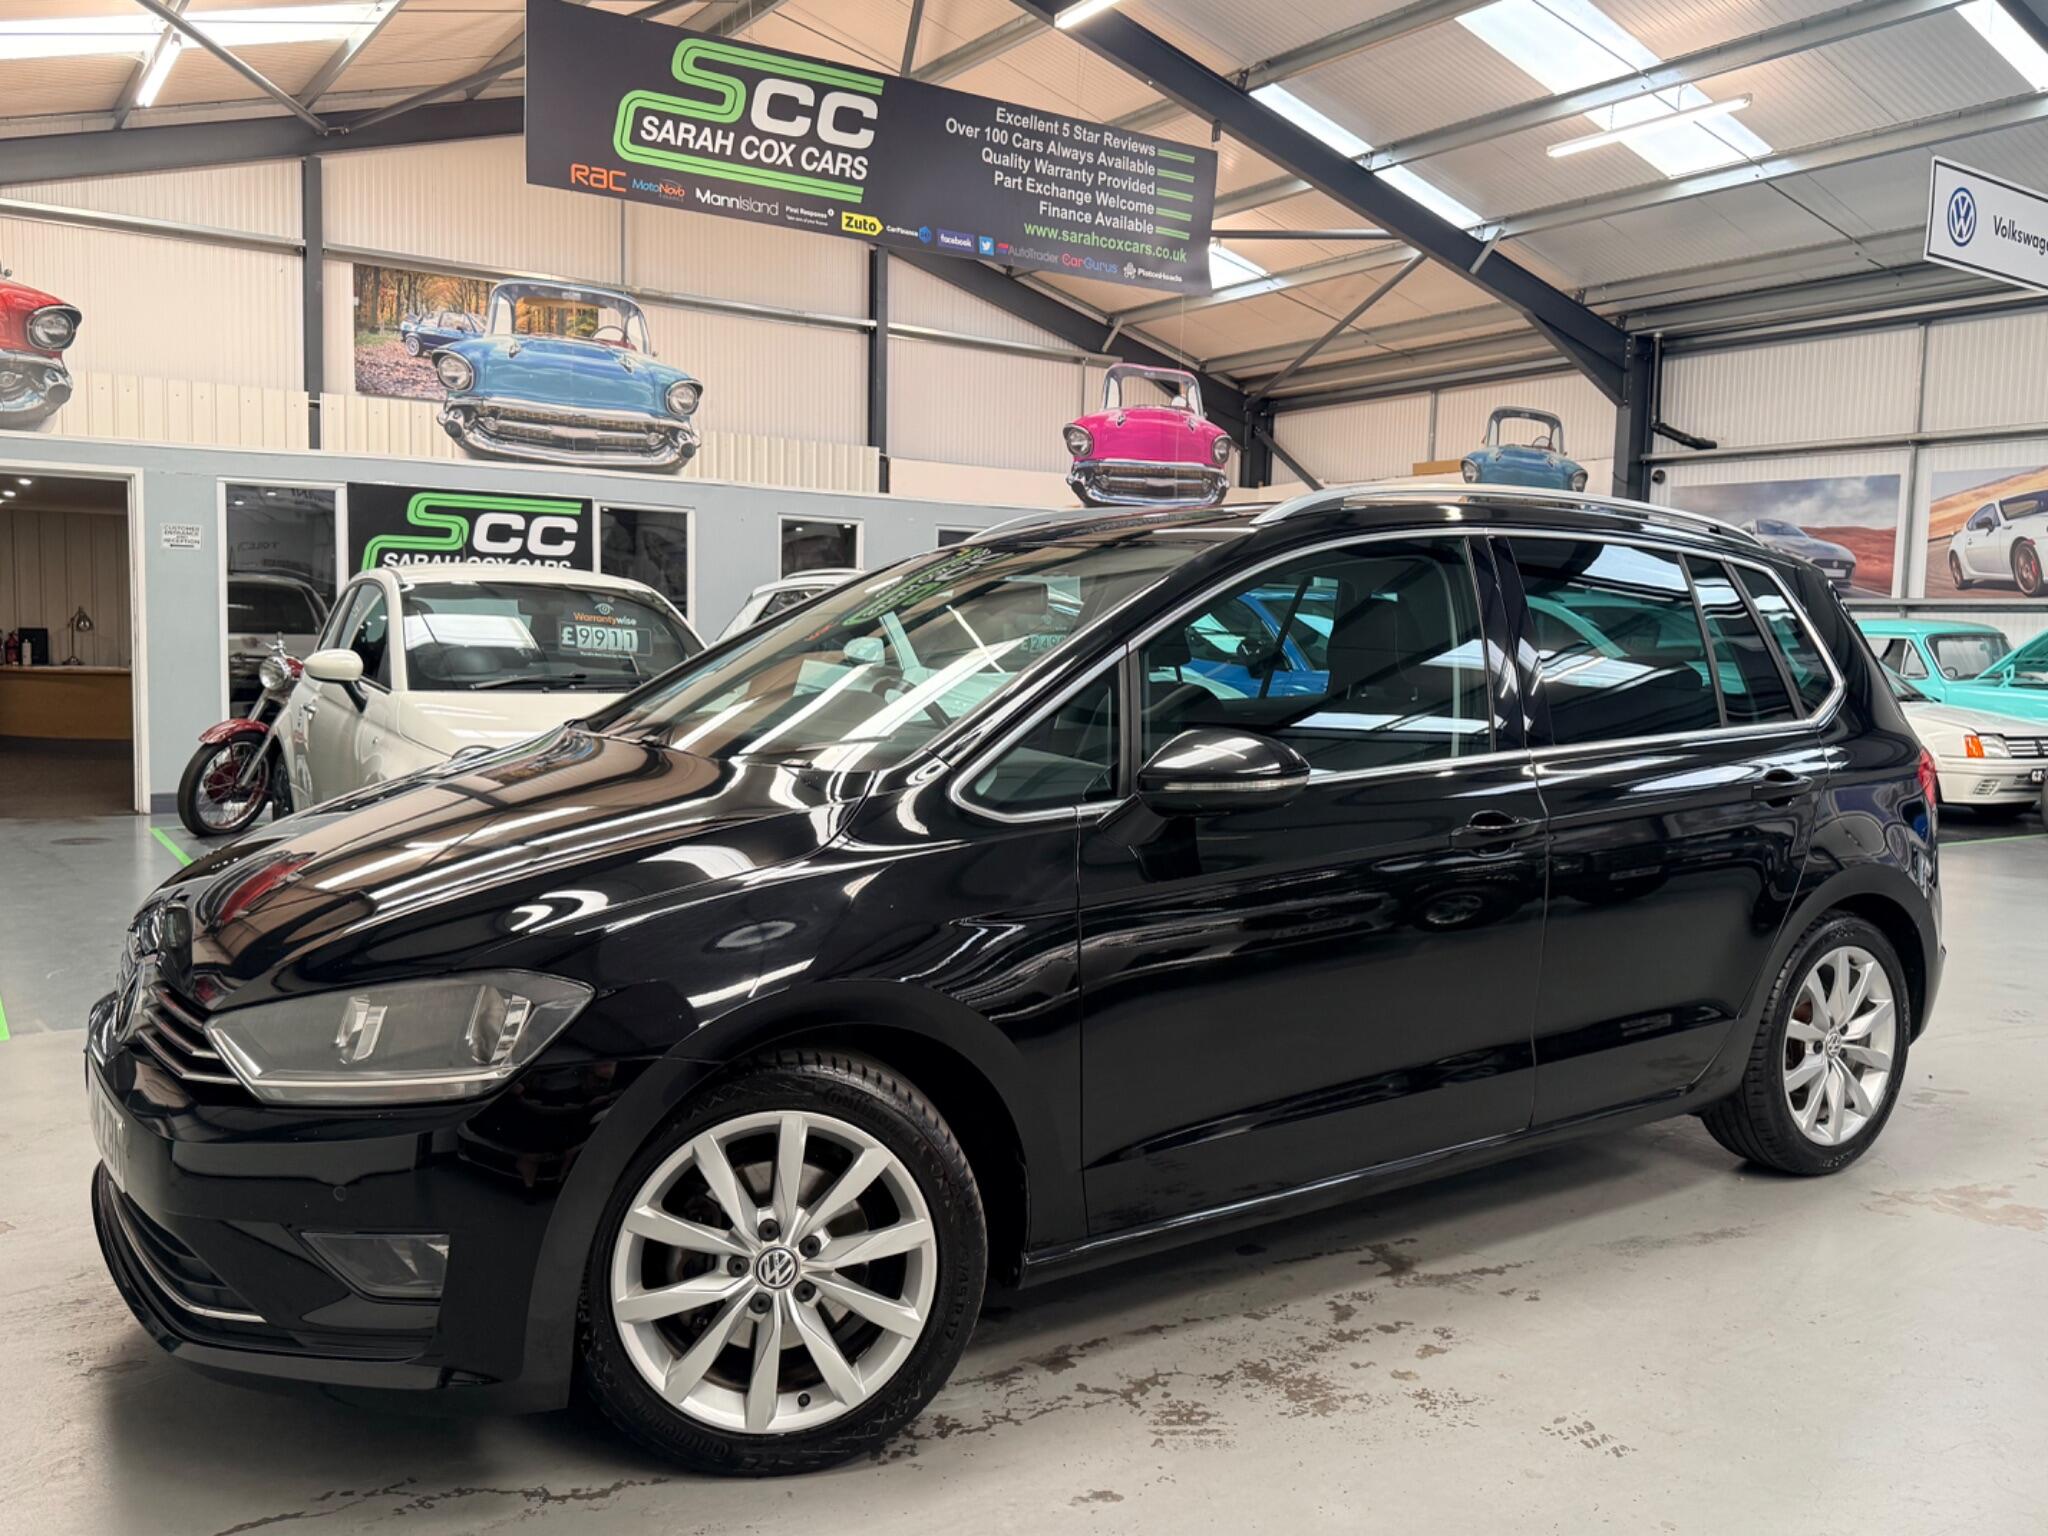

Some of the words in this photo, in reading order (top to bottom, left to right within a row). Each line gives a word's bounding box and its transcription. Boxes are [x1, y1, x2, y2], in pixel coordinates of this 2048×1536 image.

[640, 115, 735, 156] SARAH
[740, 135, 796, 167] COX
[801, 146, 868, 180] CARS
[945, 117, 980, 139] Over
[984, 126, 1008, 145] 100
[1012, 132, 1043, 153] Cars
[1046, 140, 1094, 165] Always
[1097, 151, 1155, 176] Available
[996, 107, 1059, 135] Excellent
[1062, 123, 1070, 137] 5
[1073, 125, 1100, 144] Star
[1103, 132, 1155, 157] Reviews
[981, 147, 1031, 174] Quality
[1035, 158, 1094, 187] Warranty
[1098, 171, 1155, 196] Provided
[994, 170, 1023, 191] Part
[1026, 177, 1092, 206] Exchange
[1095, 190, 1154, 215] Welcome
[845, 216, 877, 232] Zuto
[1039, 201, 1092, 224] Finance
[1095, 211, 1154, 235] Available
[940, 233, 972, 248] facebook
[1024, 222, 1187, 264] www.sarahcoxcars.co.uk
[1061, 253, 1119, 274] CarGurus
[573, 612, 637, 626] Warrantywise
[562, 626, 637, 651] £9911
